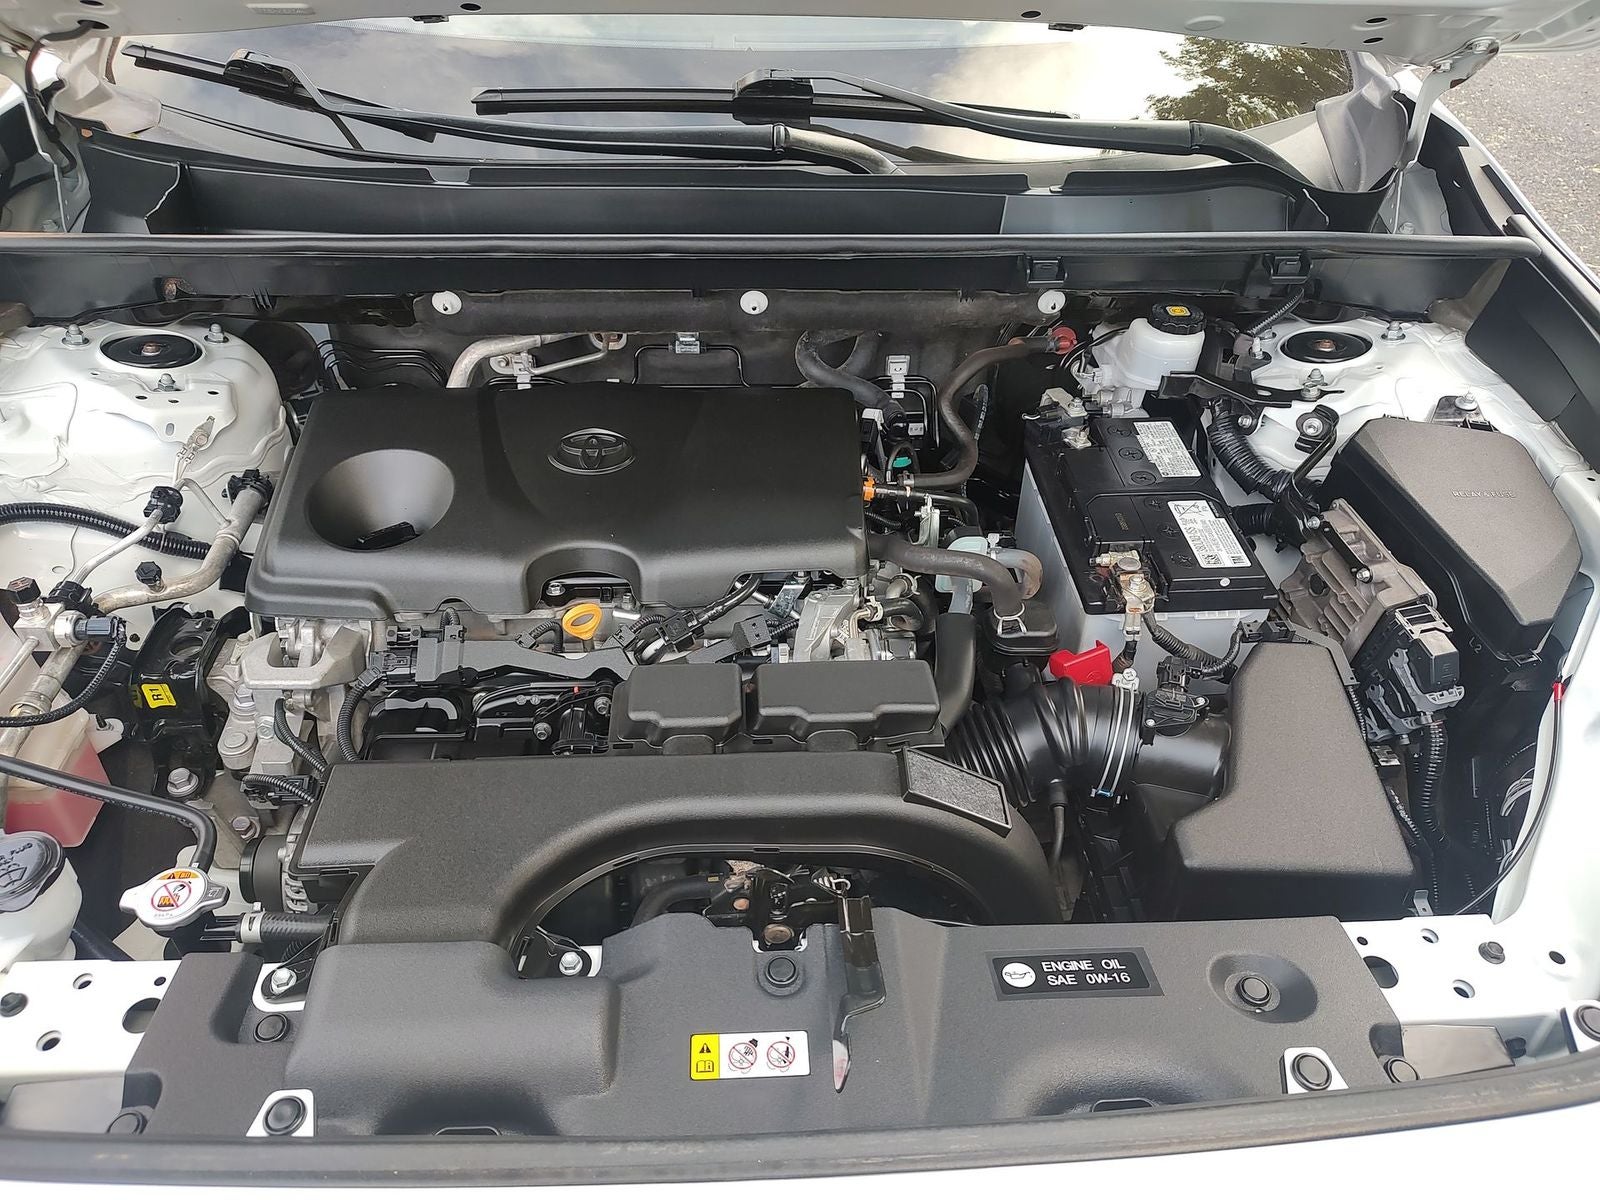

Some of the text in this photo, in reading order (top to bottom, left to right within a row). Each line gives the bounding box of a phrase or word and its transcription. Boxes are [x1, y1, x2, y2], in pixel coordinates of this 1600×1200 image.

[149, 688, 164, 701] R1
[1041, 959, 1126, 972] ENGINE OIL
[1047, 972, 1131, 986] SAE 0W-16
